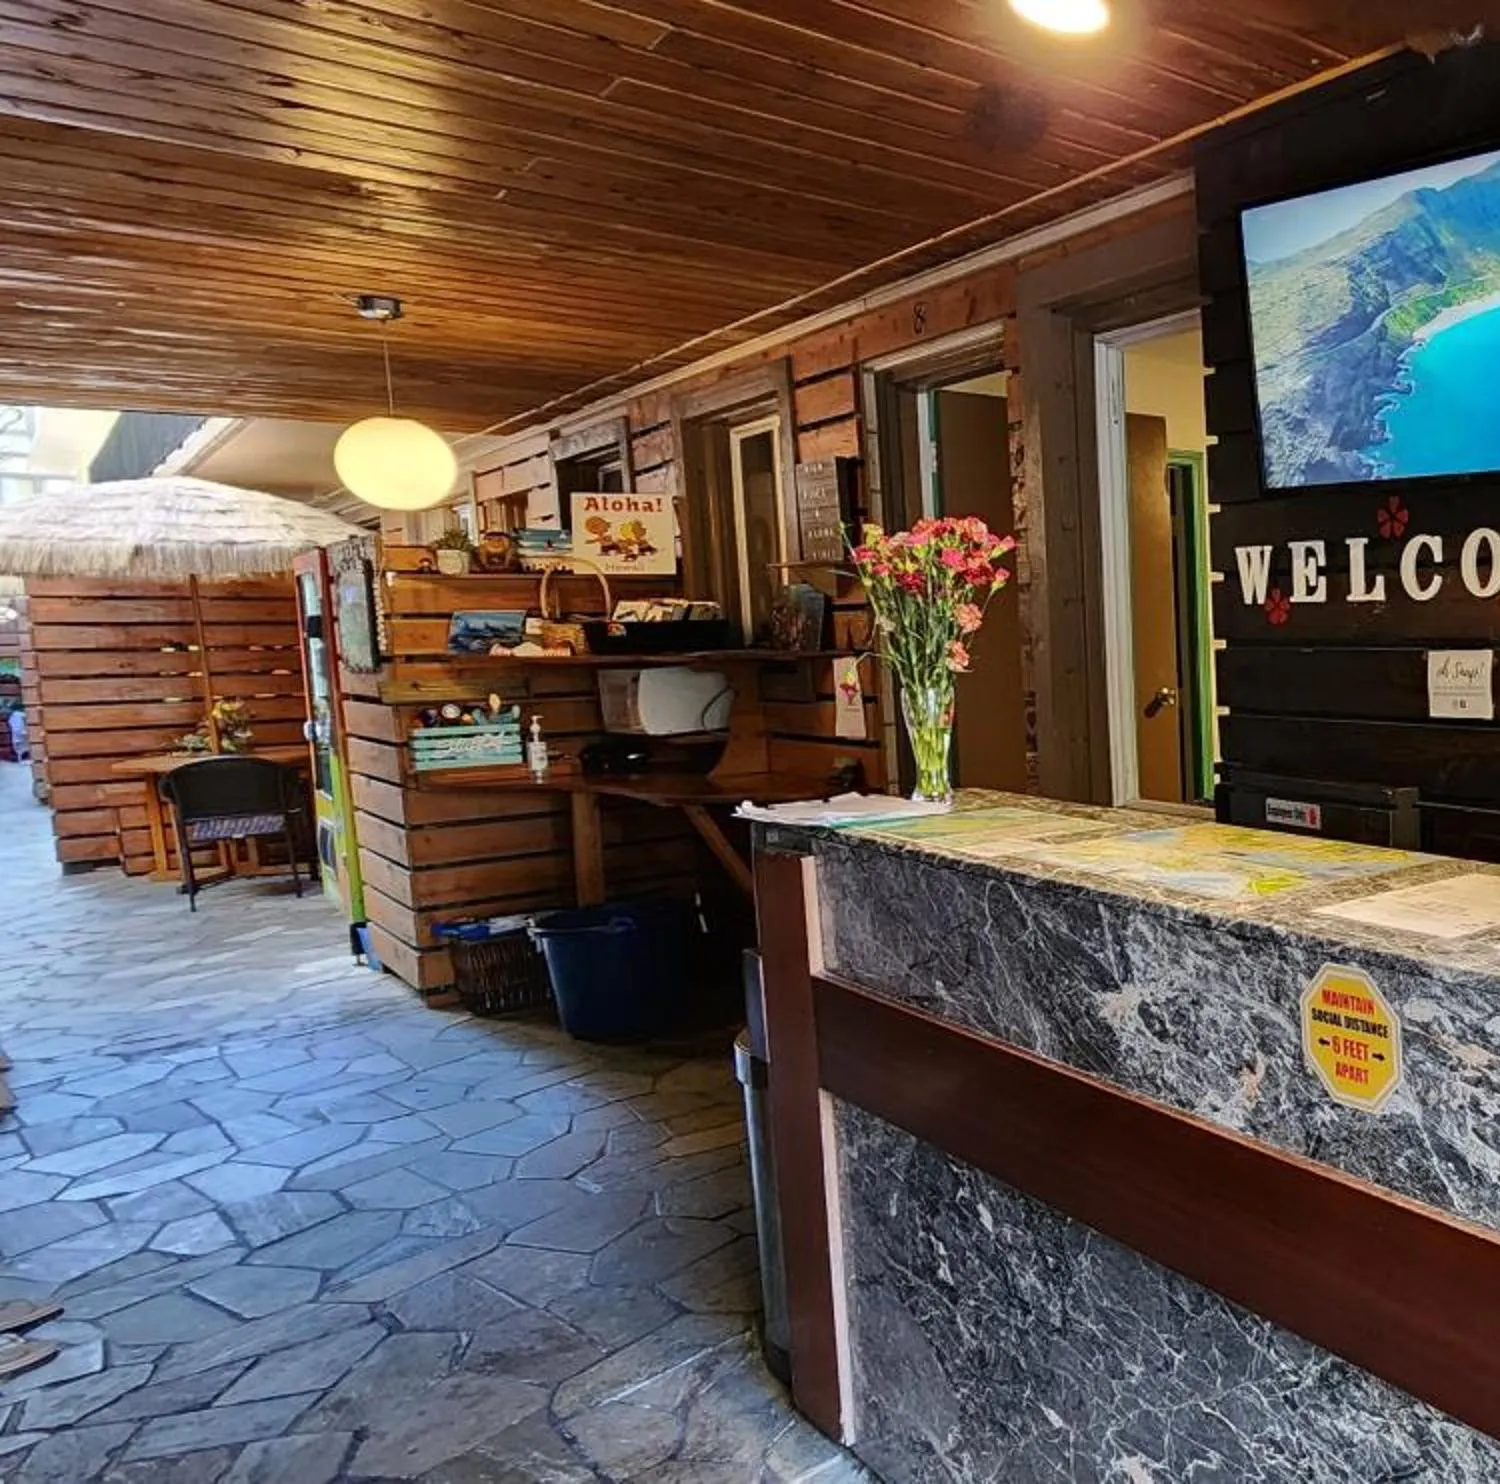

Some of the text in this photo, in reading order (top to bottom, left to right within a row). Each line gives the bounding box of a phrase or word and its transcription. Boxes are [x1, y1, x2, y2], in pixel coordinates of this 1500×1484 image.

[584, 496, 663, 513] Aloha!
[1322, 990, 1375, 1014] MAINTAIN
[1311, 1008, 1388, 1038] SOCIAL DISTANCE
[1331, 1035, 1368, 1061] 6 FEET
[1335, 1061, 1368, 1084] APART
